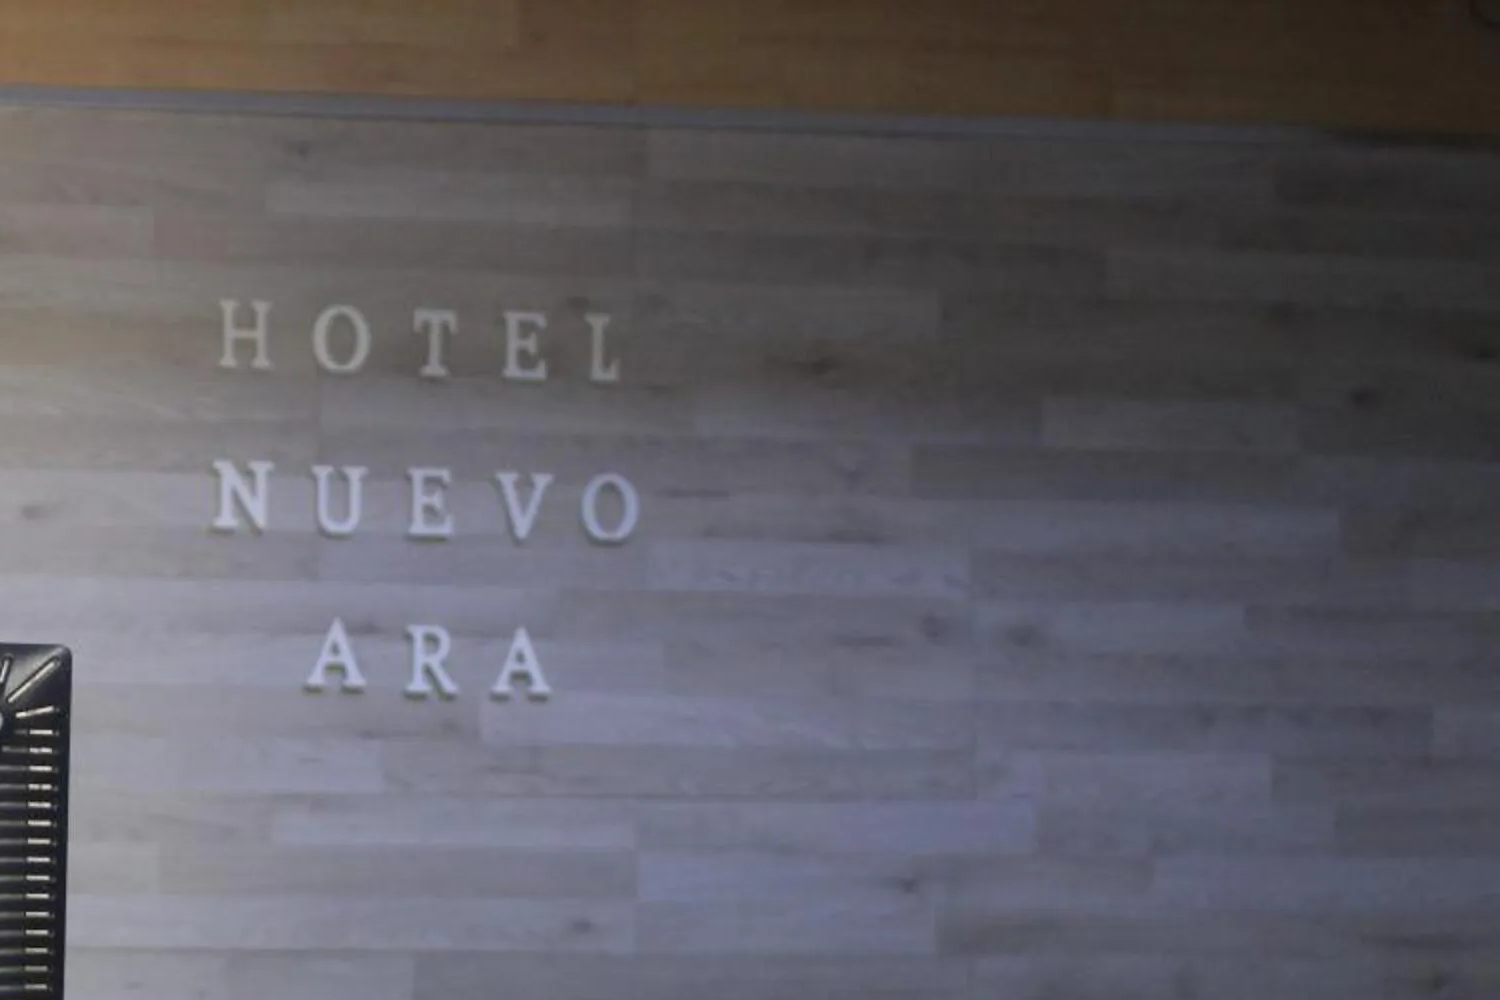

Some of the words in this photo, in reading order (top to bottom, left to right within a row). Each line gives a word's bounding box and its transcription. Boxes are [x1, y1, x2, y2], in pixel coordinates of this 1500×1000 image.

[218, 298, 620, 382] HOTEL
[211, 459, 640, 544] NUEVO
[304, 616, 553, 699] ARA
